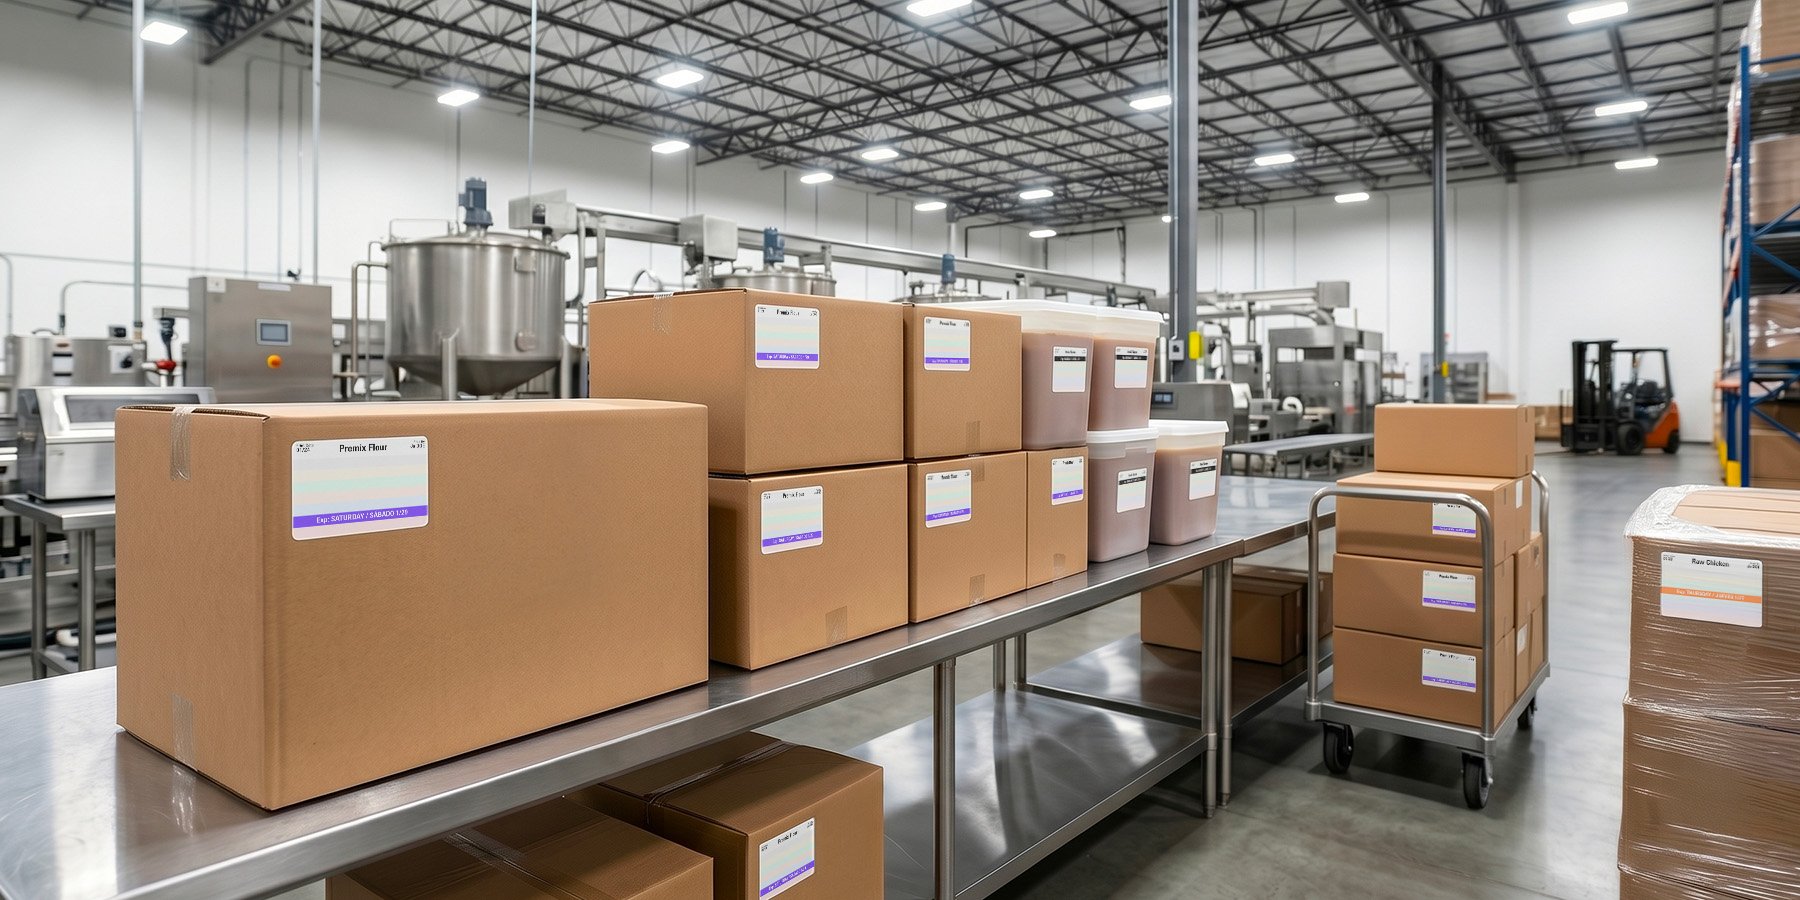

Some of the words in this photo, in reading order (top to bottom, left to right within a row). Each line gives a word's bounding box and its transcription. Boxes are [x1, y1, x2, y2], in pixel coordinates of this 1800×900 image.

[339, 444, 367, 452] Premix
[368, 443, 387, 451] Flour
[331, 513, 365, 522] SATURDAY
